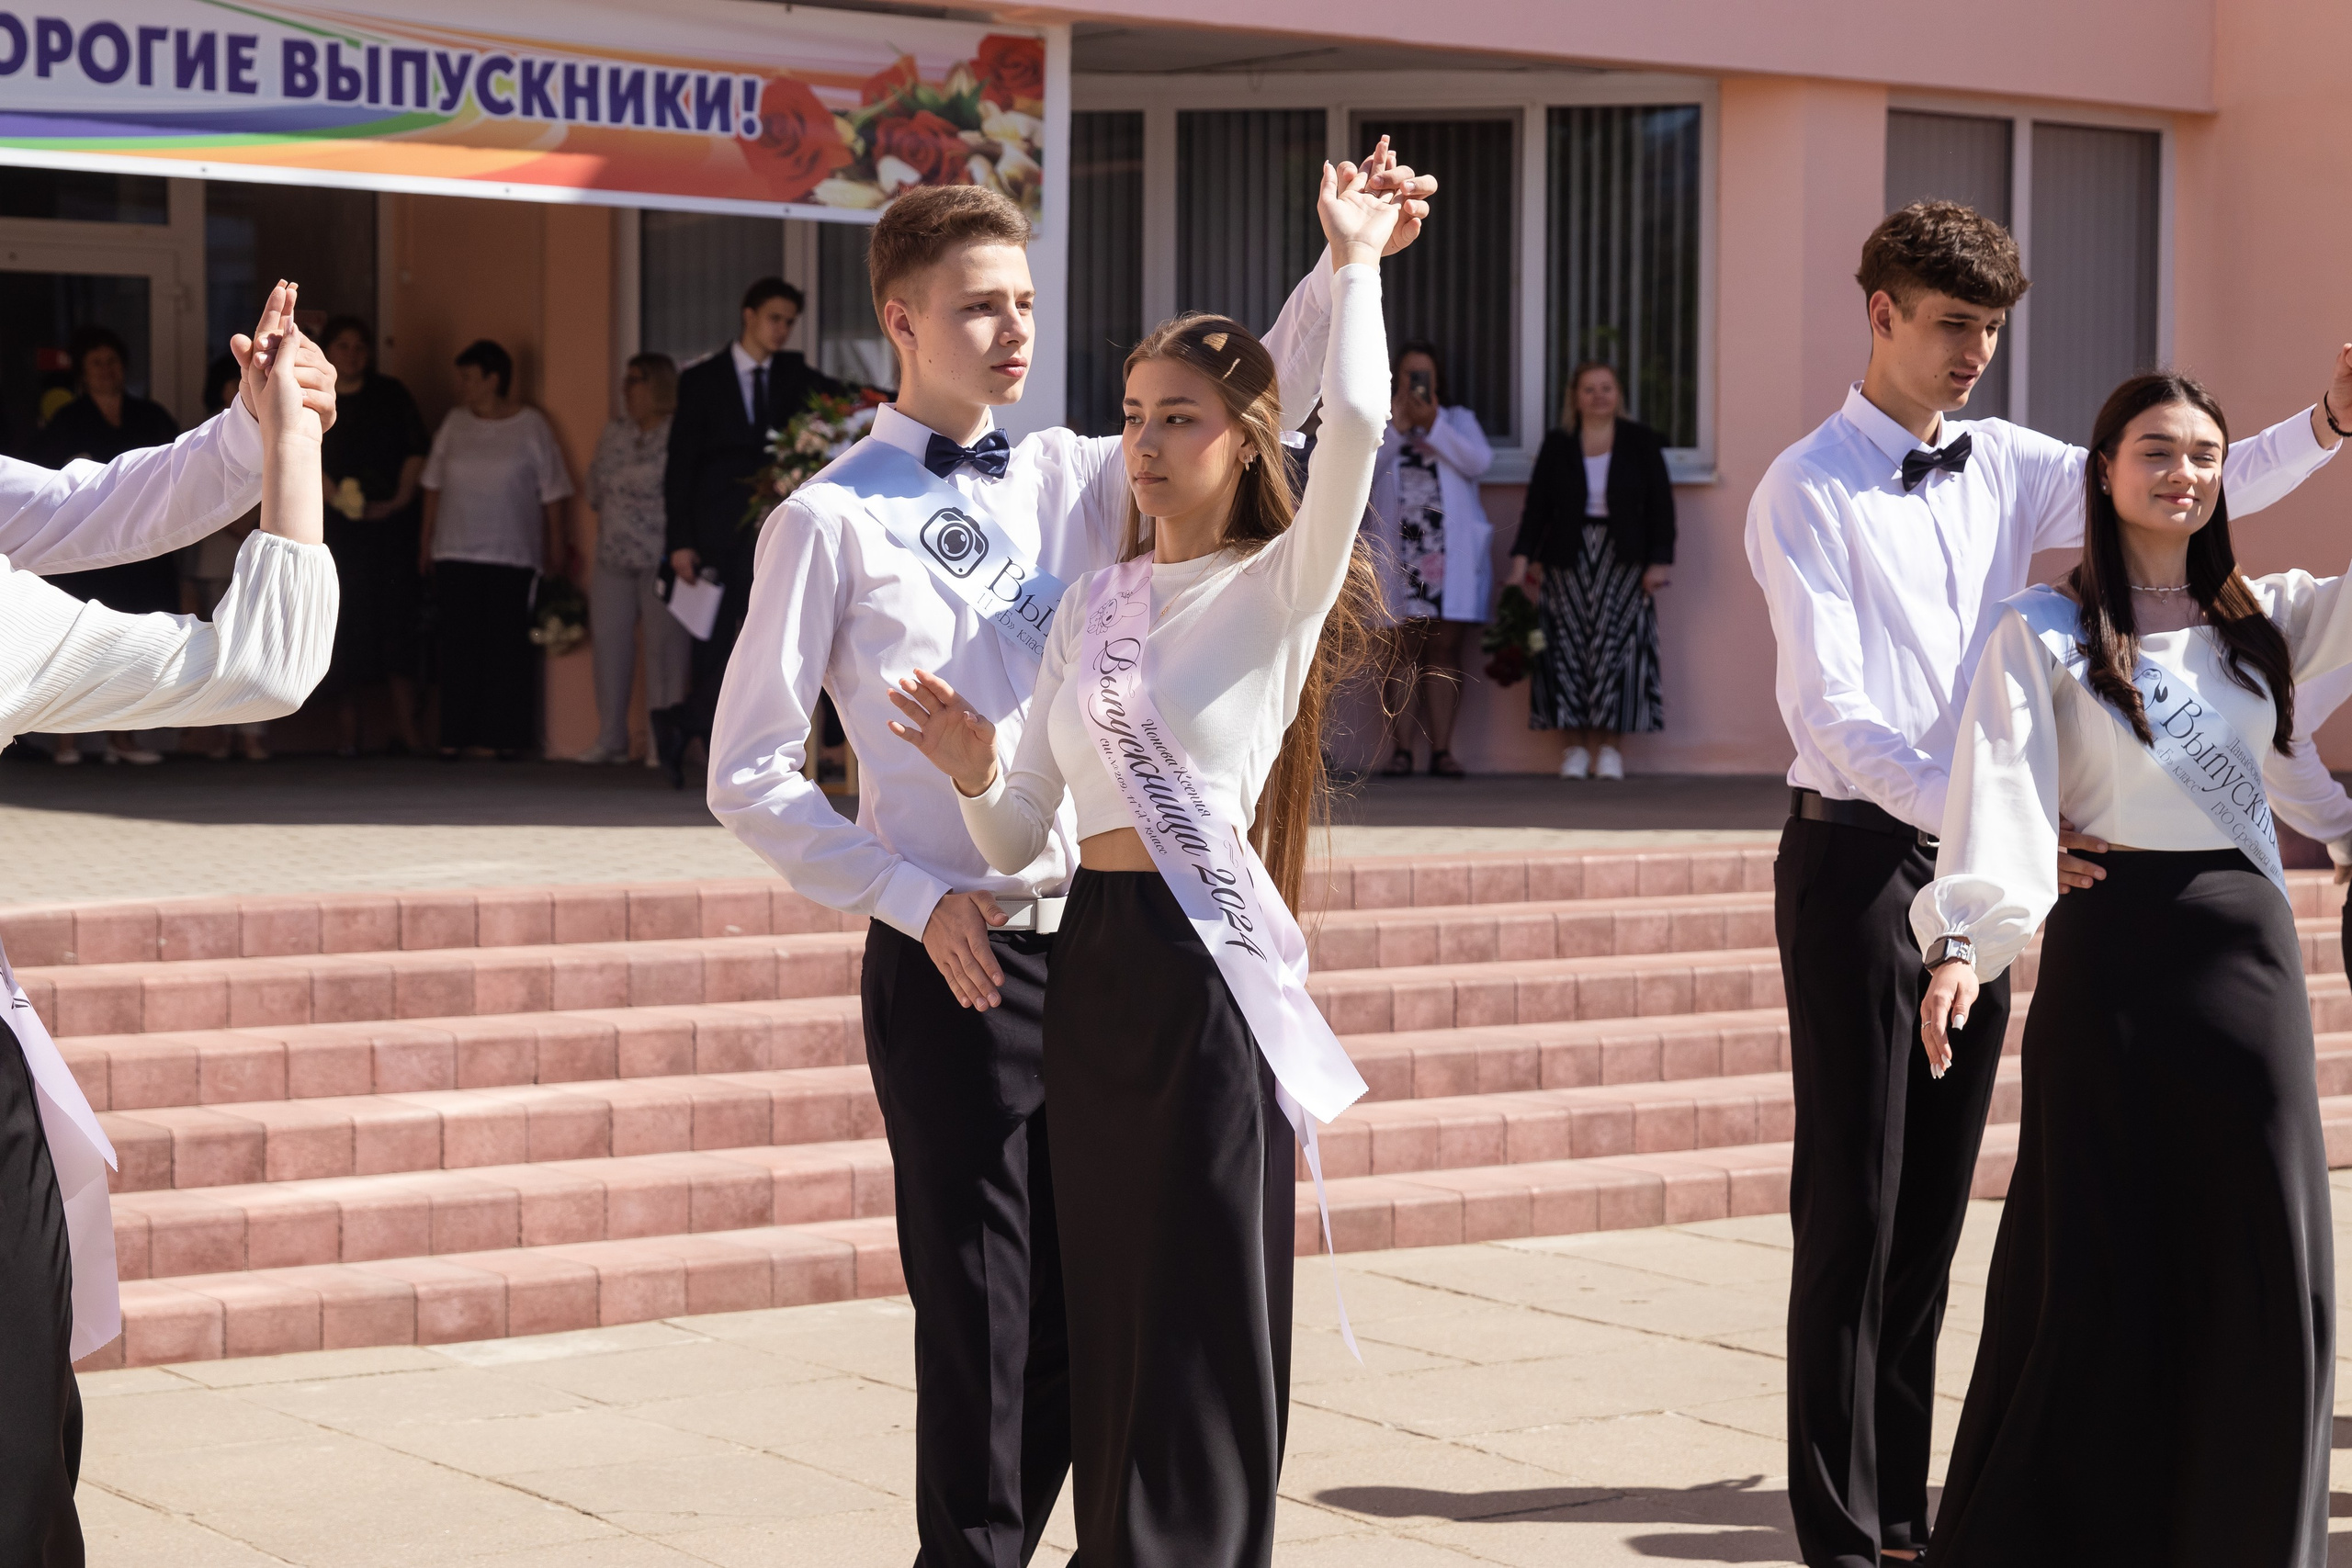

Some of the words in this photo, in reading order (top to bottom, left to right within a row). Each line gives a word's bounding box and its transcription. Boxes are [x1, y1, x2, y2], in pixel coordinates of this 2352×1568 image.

[282, 38, 757, 136] ВЫПУСКНИКИ!
[985, 556, 1056, 638] Вы
[994, 609, 1015, 631] «Б»
[1088, 637, 1212, 857] Выпускница
[1191, 863, 1268, 964] 2024
[1140, 718, 1179, 767] Ионова
[1172, 766, 1212, 818] Ксения
[2159, 696, 2279, 856] Выпускни
[2172, 765, 2201, 794] класс
[1144, 826, 1168, 856] класс
